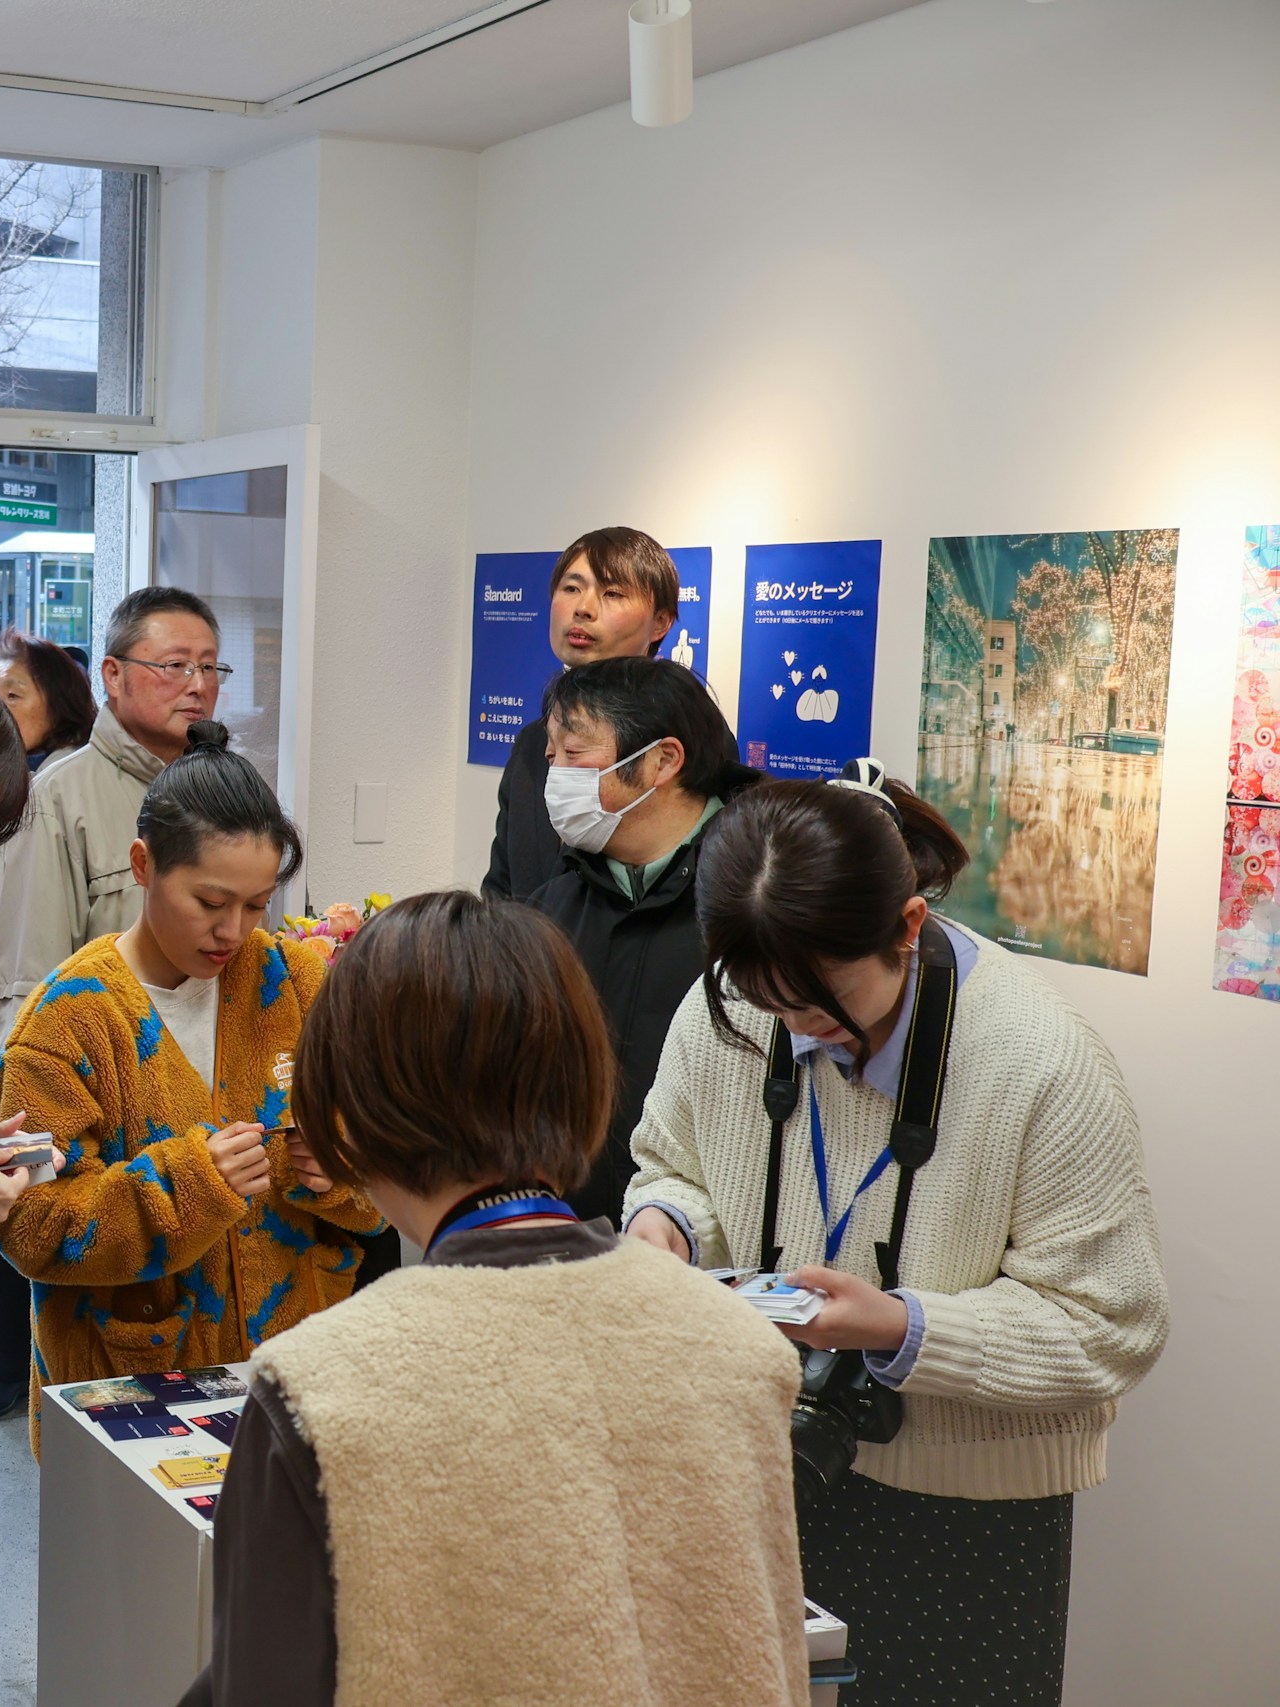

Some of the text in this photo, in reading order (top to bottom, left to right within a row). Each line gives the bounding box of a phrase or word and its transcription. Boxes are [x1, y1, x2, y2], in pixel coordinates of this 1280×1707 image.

[3, 482, 37, 498] 宮城トヨタ
[484, 587, 522, 602] standard
[755, 580, 854, 601] 愛のメッセージ
[488, 695, 524, 707] ちがいを楽しむ
[487, 714, 523, 725] こえに寄り添う
[797, 1391, 818, 1402] ikon
